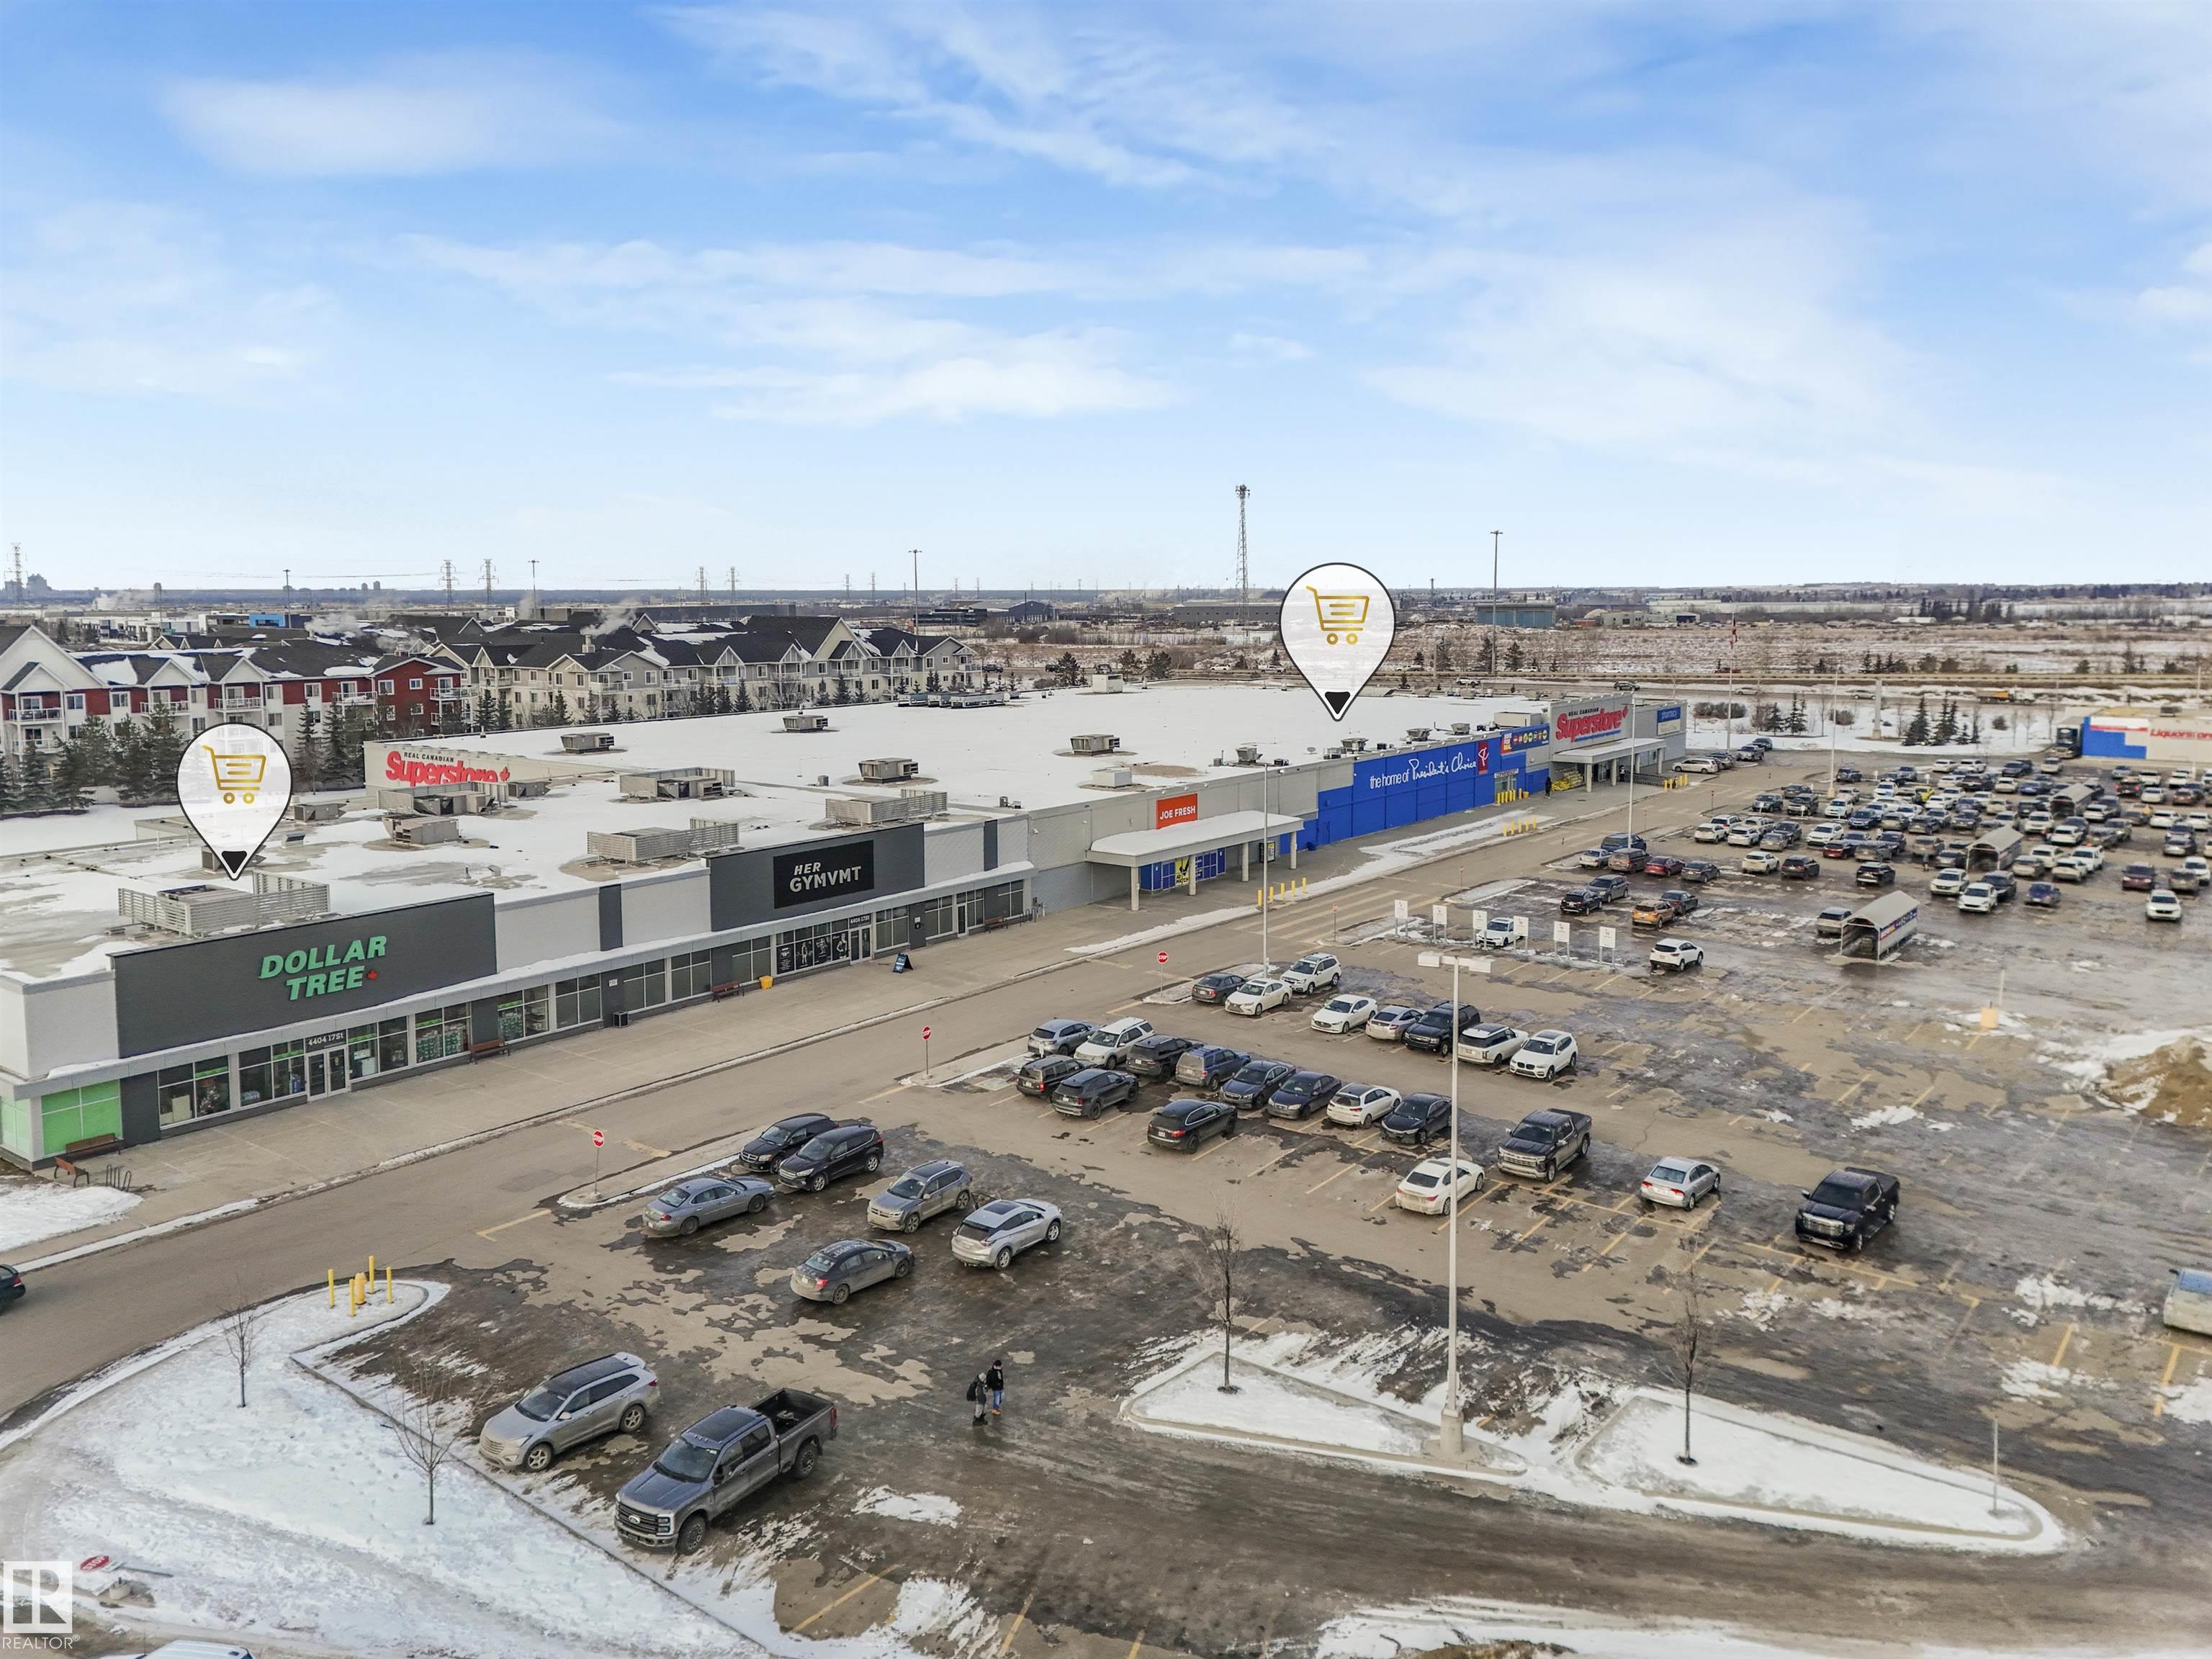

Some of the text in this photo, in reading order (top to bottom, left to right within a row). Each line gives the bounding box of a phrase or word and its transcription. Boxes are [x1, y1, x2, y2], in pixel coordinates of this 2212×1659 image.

[1555, 708, 1622, 743] Superstore
[385, 750, 498, 788] Superstore
[422, 754, 454, 763] CANADIAN
[1370, 752, 1477, 789] the home of President's Choice
[1159, 805, 1195, 819] JOE FRESH
[789, 866, 862, 892] GYMVMT
[793, 862, 822, 876] HER
[259, 935, 387, 980] DOLLAR
[286, 965, 365, 1001] TREE
[308, 1037, 327, 1046] 4404
[82, 1555, 105, 1570] STOP
